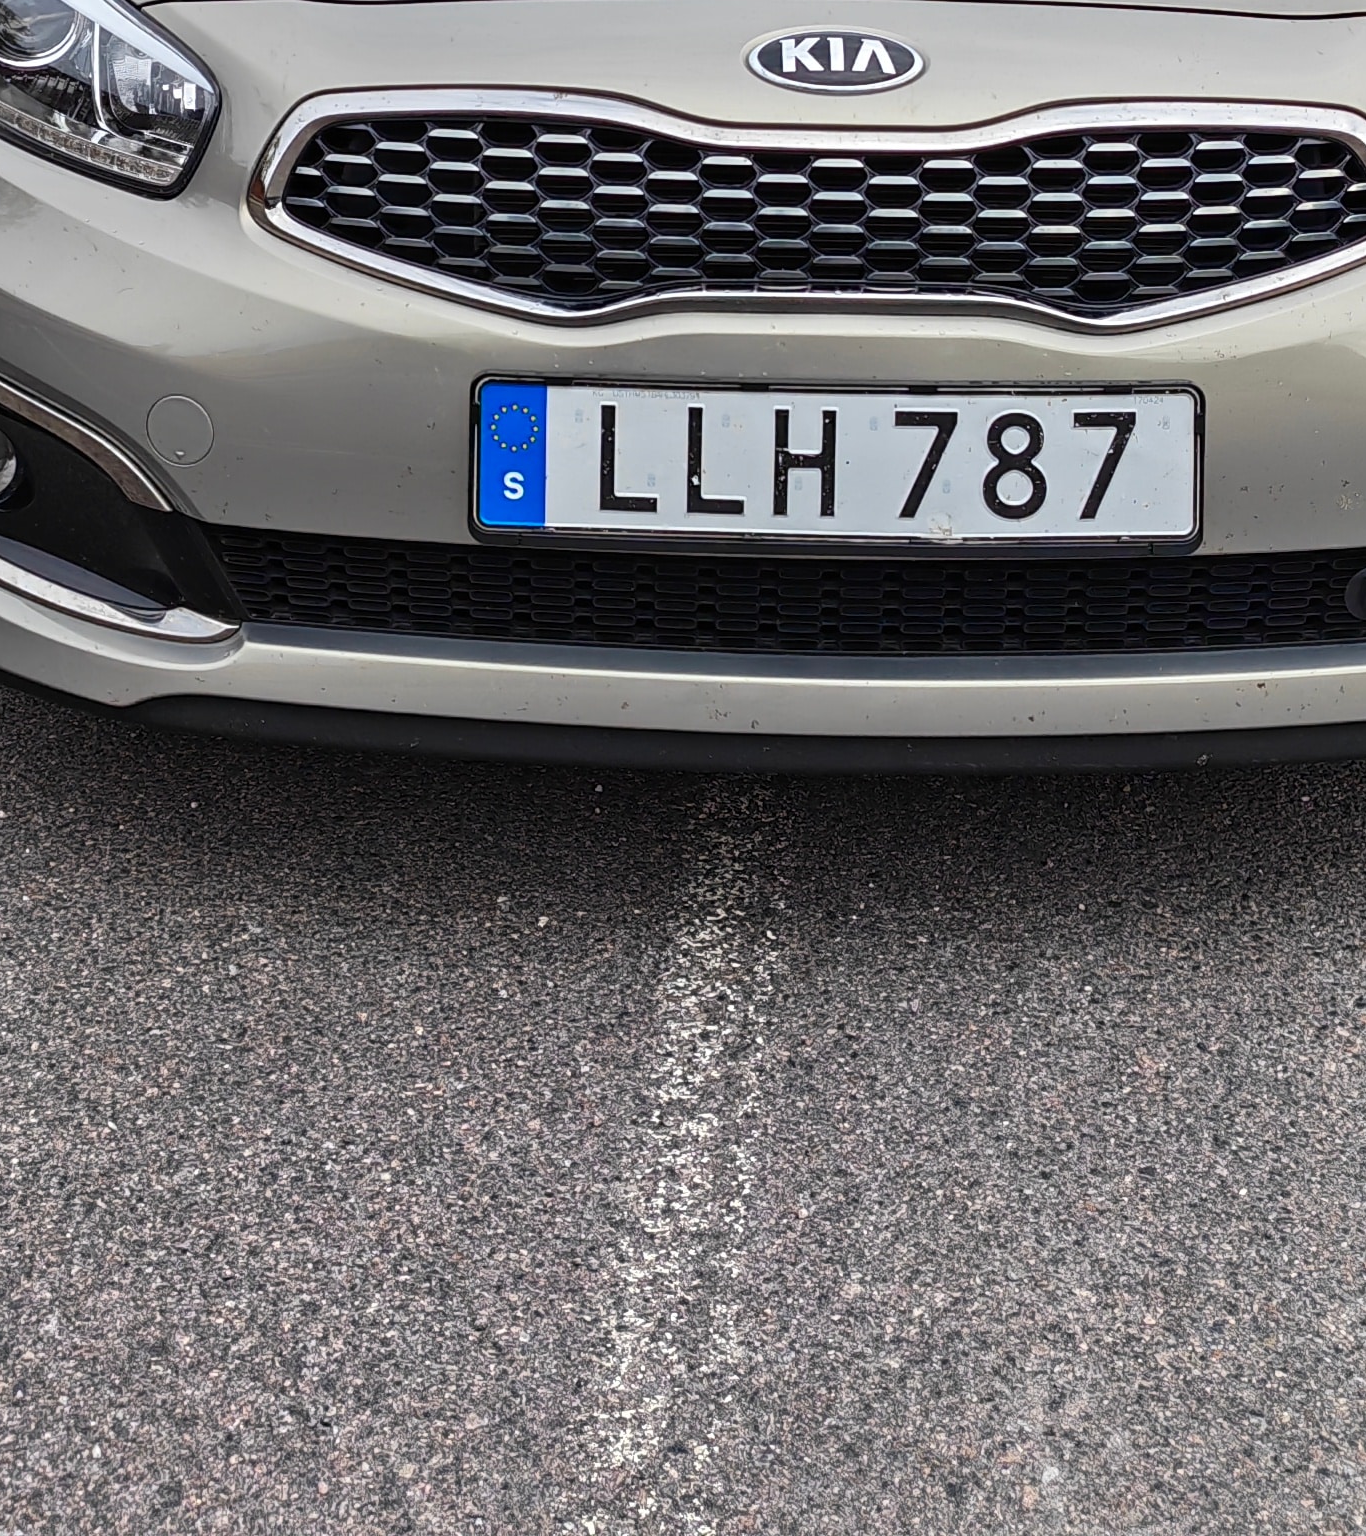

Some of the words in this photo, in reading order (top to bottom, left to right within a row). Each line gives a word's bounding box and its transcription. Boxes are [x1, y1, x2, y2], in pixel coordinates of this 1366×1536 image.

[779, 37, 897, 75] KIA
[599, 403, 837, 516] LLH
[893, 409, 1138, 520] 787
[503, 471, 525, 500] S
